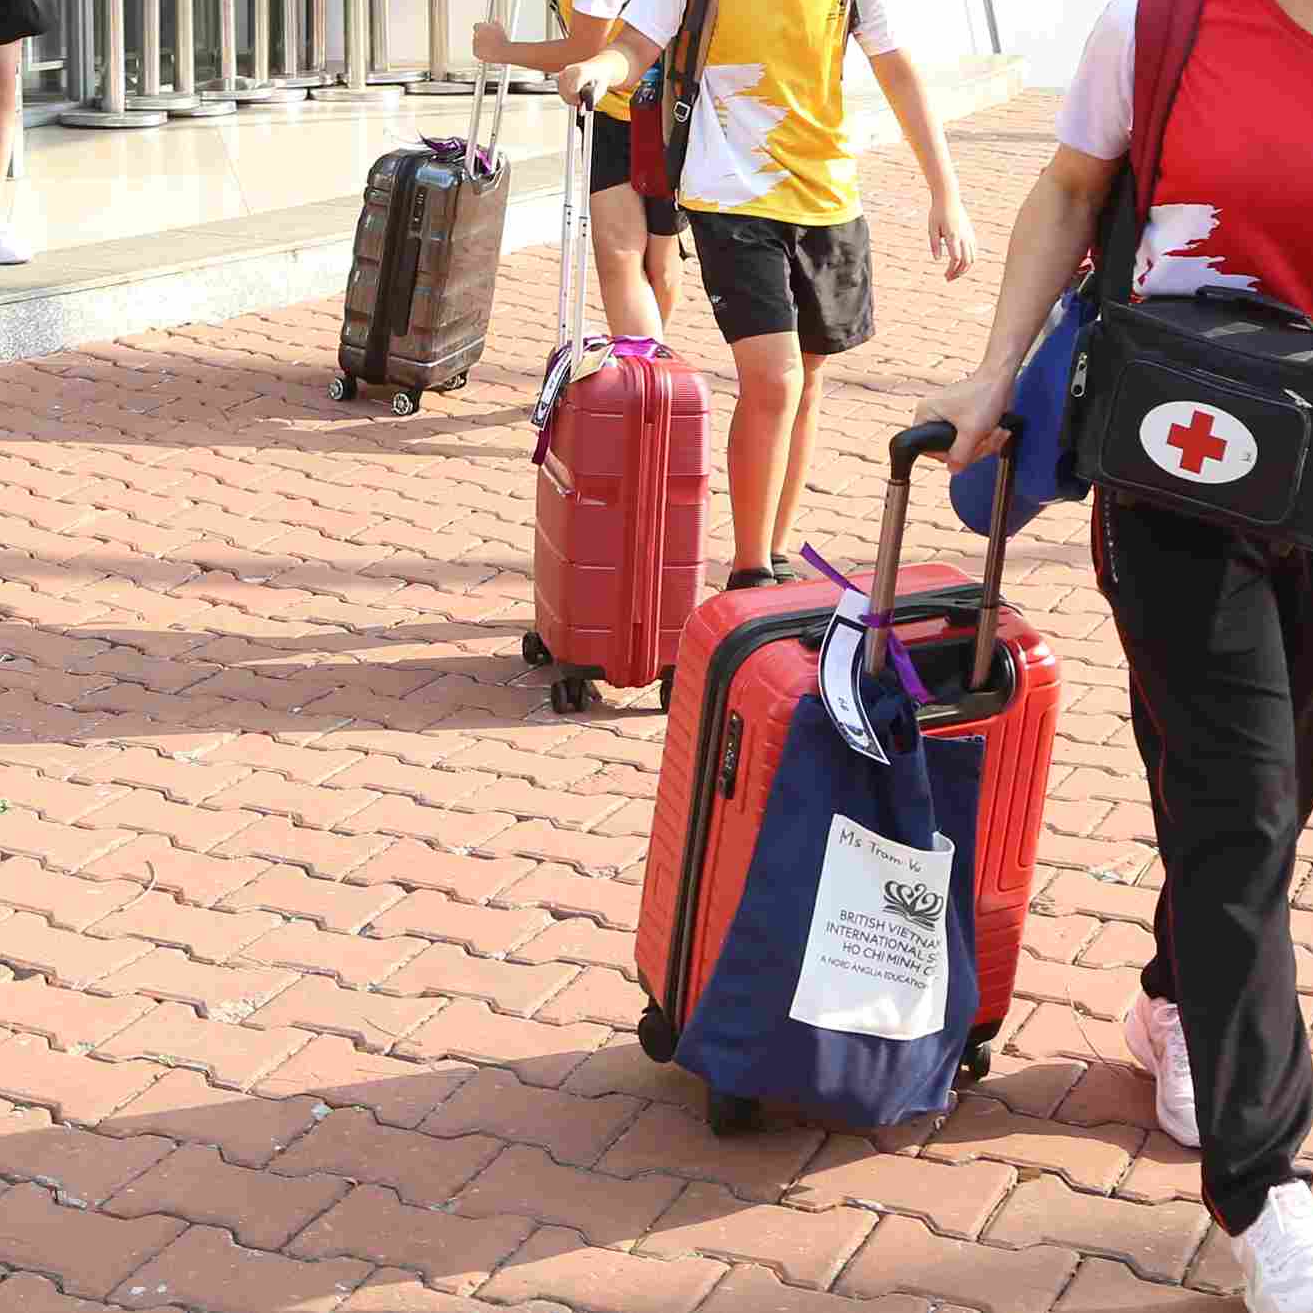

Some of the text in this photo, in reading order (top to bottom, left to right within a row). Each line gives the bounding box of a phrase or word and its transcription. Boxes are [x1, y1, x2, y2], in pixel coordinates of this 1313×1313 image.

[839, 829, 863, 848] Ms
[839, 909, 886, 933] BRITISH
[825, 920, 926, 961] INTERNATIONAL
[842, 942, 861, 956] HO
[863, 947, 885, 961] CHI
[886, 953, 921, 973] MINH
